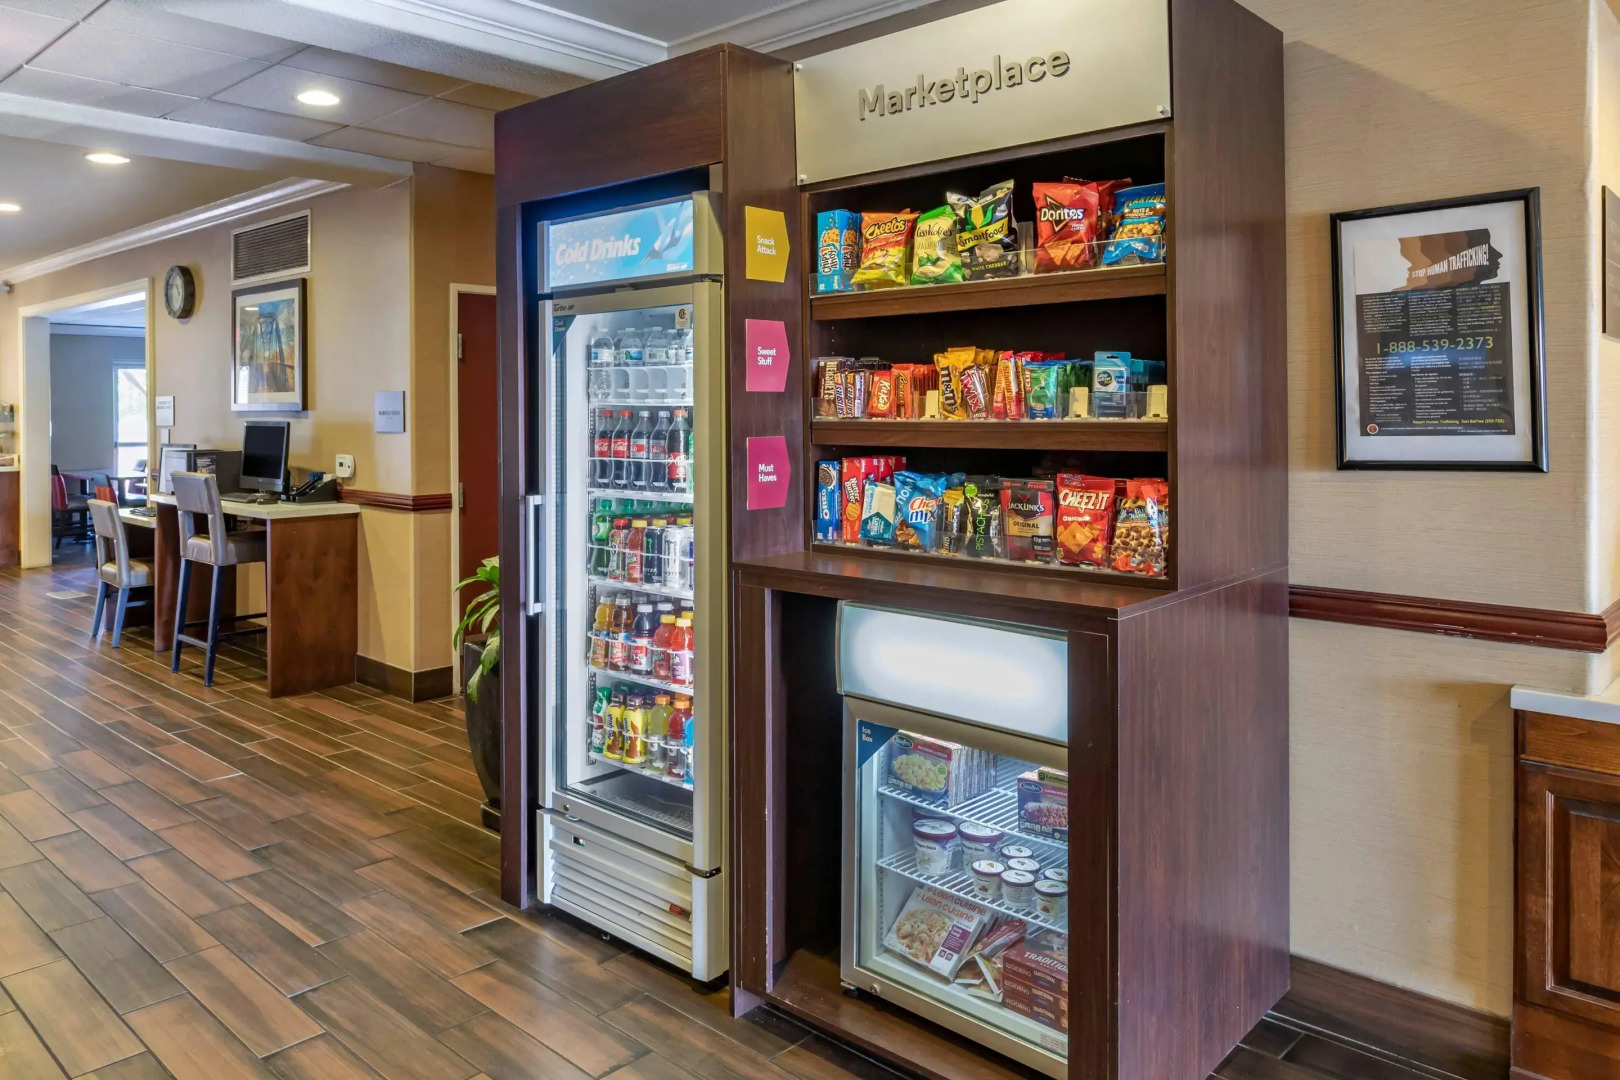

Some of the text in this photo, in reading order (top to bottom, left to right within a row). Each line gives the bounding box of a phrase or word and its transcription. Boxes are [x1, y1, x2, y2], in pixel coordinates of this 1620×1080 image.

[858, 50, 1071, 121] Marketplace
[1040, 207, 1084, 222] Doritos
[866, 217, 907, 240] Cheetos
[957, 223, 1005, 247] Smartfood
[757, 235, 775, 246] Snack
[555, 234, 641, 266] Cold Drinks
[757, 244, 777, 255] Attack
[822, 252, 831, 273] Chips
[1412, 243, 1489, 278] STOP HUMAN TRAFFICKING!
[553, 303, 575, 312] Turbo air
[758, 346, 776, 356] Sweet
[1377, 336, 1493, 354] 1-888-539-2373
[758, 357, 772, 365] Stuff
[824, 361, 838, 400] HERSHEY'S
[836, 385, 844, 417] SATISFIES
[758, 463, 774, 472] Must
[758, 473, 777, 482] Haves
[844, 480, 855, 504] Butter
[849, 477, 859, 501] Nutter
[909, 497, 942, 511] Chex
[1008, 502, 1023, 510] JACK
[909, 509, 936, 524] mix
[1013, 520, 1039, 529] ORIGINAL
[862, 726, 871, 735] Ice
[862, 734, 873, 743] Box
